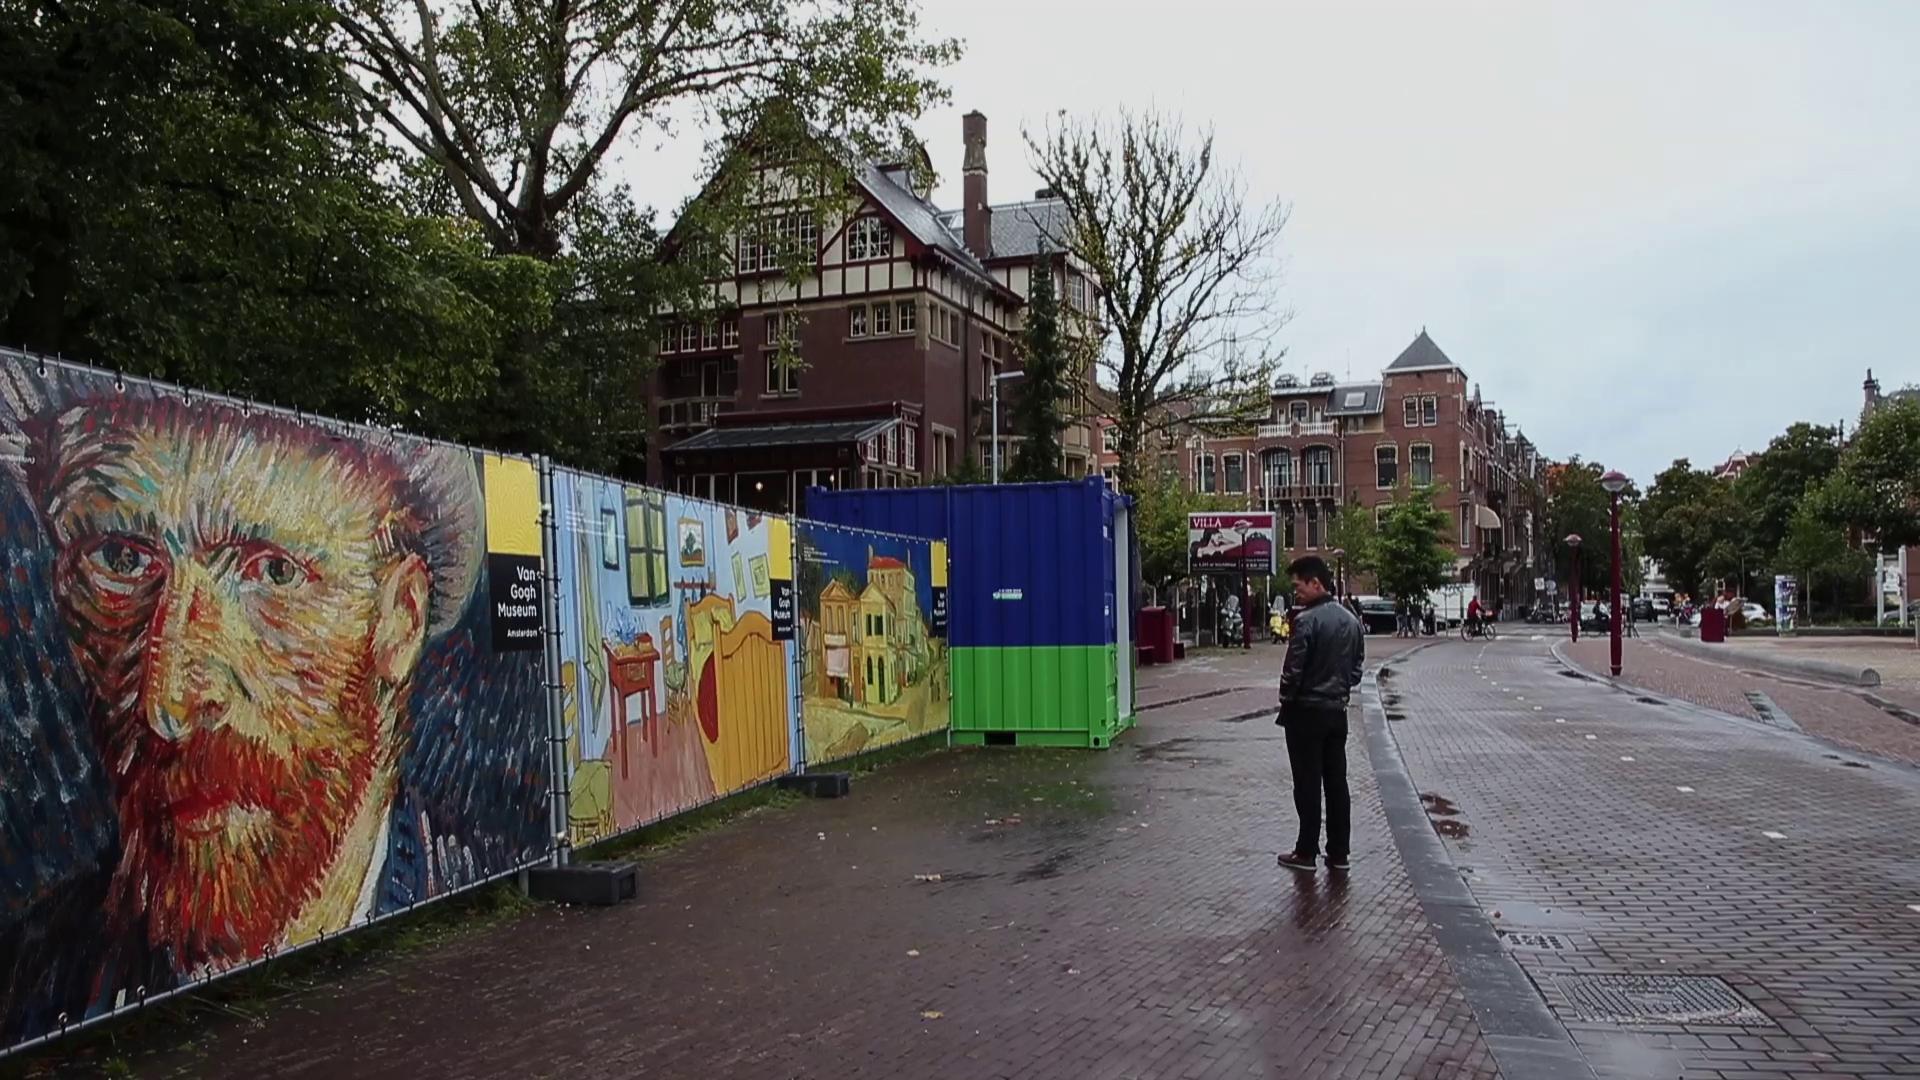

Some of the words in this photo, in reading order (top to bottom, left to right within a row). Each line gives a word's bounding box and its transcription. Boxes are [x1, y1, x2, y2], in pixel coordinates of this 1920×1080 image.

[1193, 517, 1222, 528] VILLA
[516, 566, 536, 581] Van
[510, 583, 536, 602] Gogh
[497, 602, 537, 617] Museum
[507, 628, 538, 638] Amsterdam
